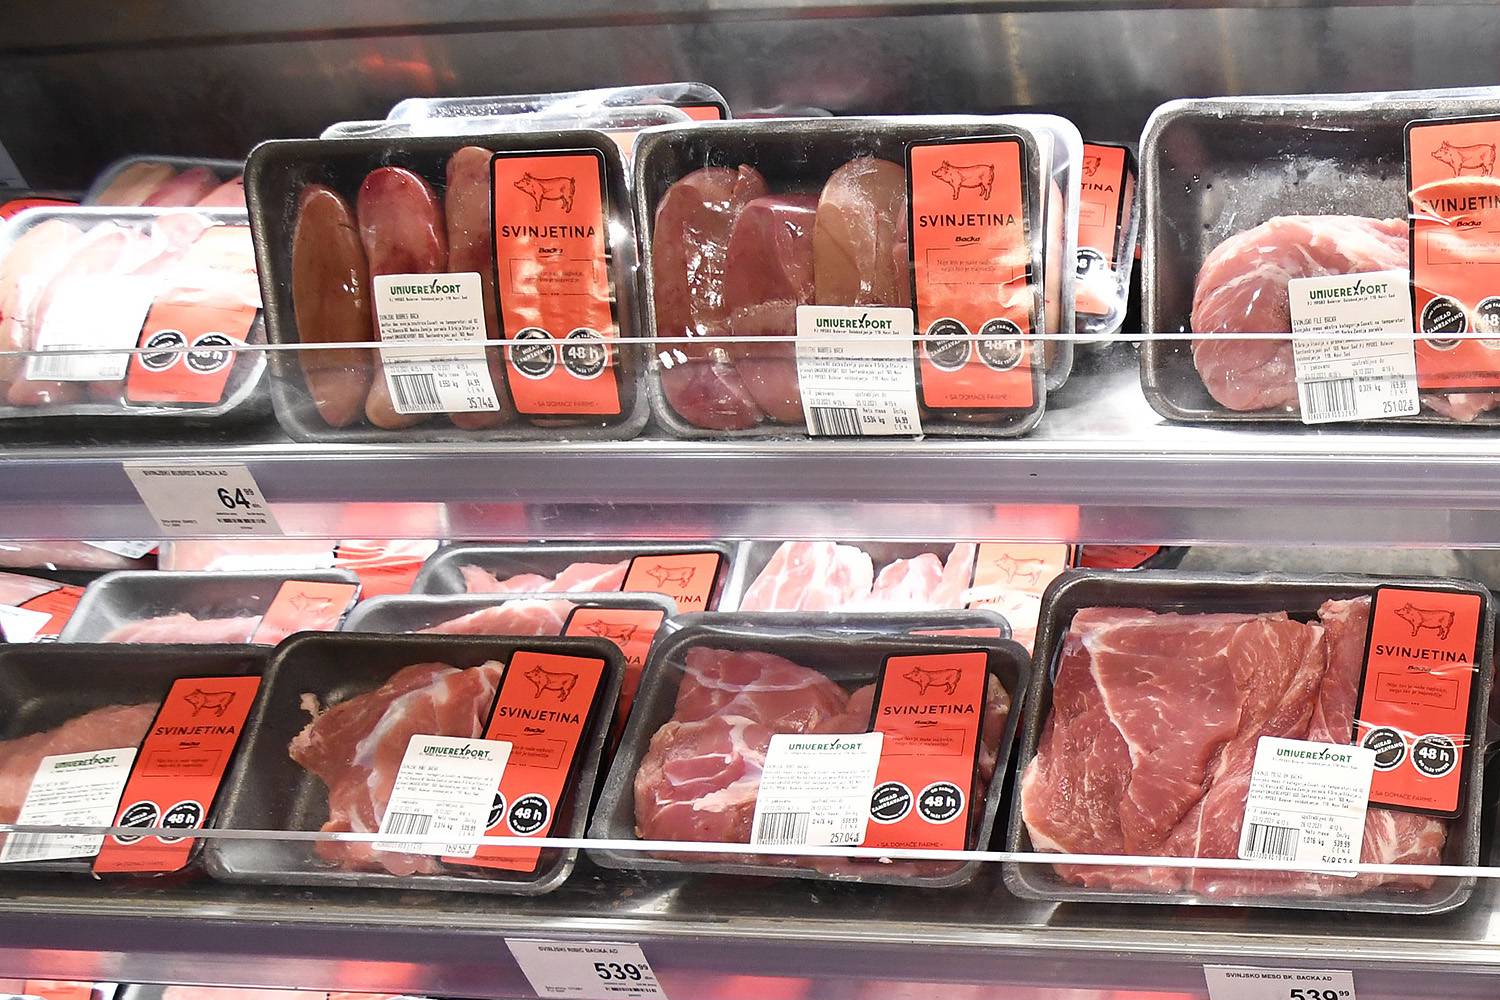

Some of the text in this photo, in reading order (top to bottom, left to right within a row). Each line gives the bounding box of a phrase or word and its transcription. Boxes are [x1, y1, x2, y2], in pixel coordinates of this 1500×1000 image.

[920, 214, 1016, 228] SVINJETINA
[502, 226, 595, 239] SVINJETINA
[390, 280, 461, 295] UNIVEREXPORT
[1309, 281, 1387, 300] UNIVEREXPORT
[816, 315, 892, 329] UNIVEREXPORT
[218, 488, 250, 509] 64
[1376, 645, 1468, 664] SVINJETINA
[500, 707, 580, 725] SVINJETINA
[884, 704, 975, 715] SVINJETINA
[154, 726, 236, 736] SVINJETINA
[423, 745, 491, 758] UNIVEREXPORT
[789, 740, 862, 750] UNIVEREXPORT
[1277, 749, 1352, 763] UNIVEREXPORT
[1418, 747, 1449, 762] 48 h
[925, 796, 956, 807] 48 h
[167, 814, 194, 824] 48 h
[515, 808, 542, 820] 48 h
[594, 963, 641, 980] 539
